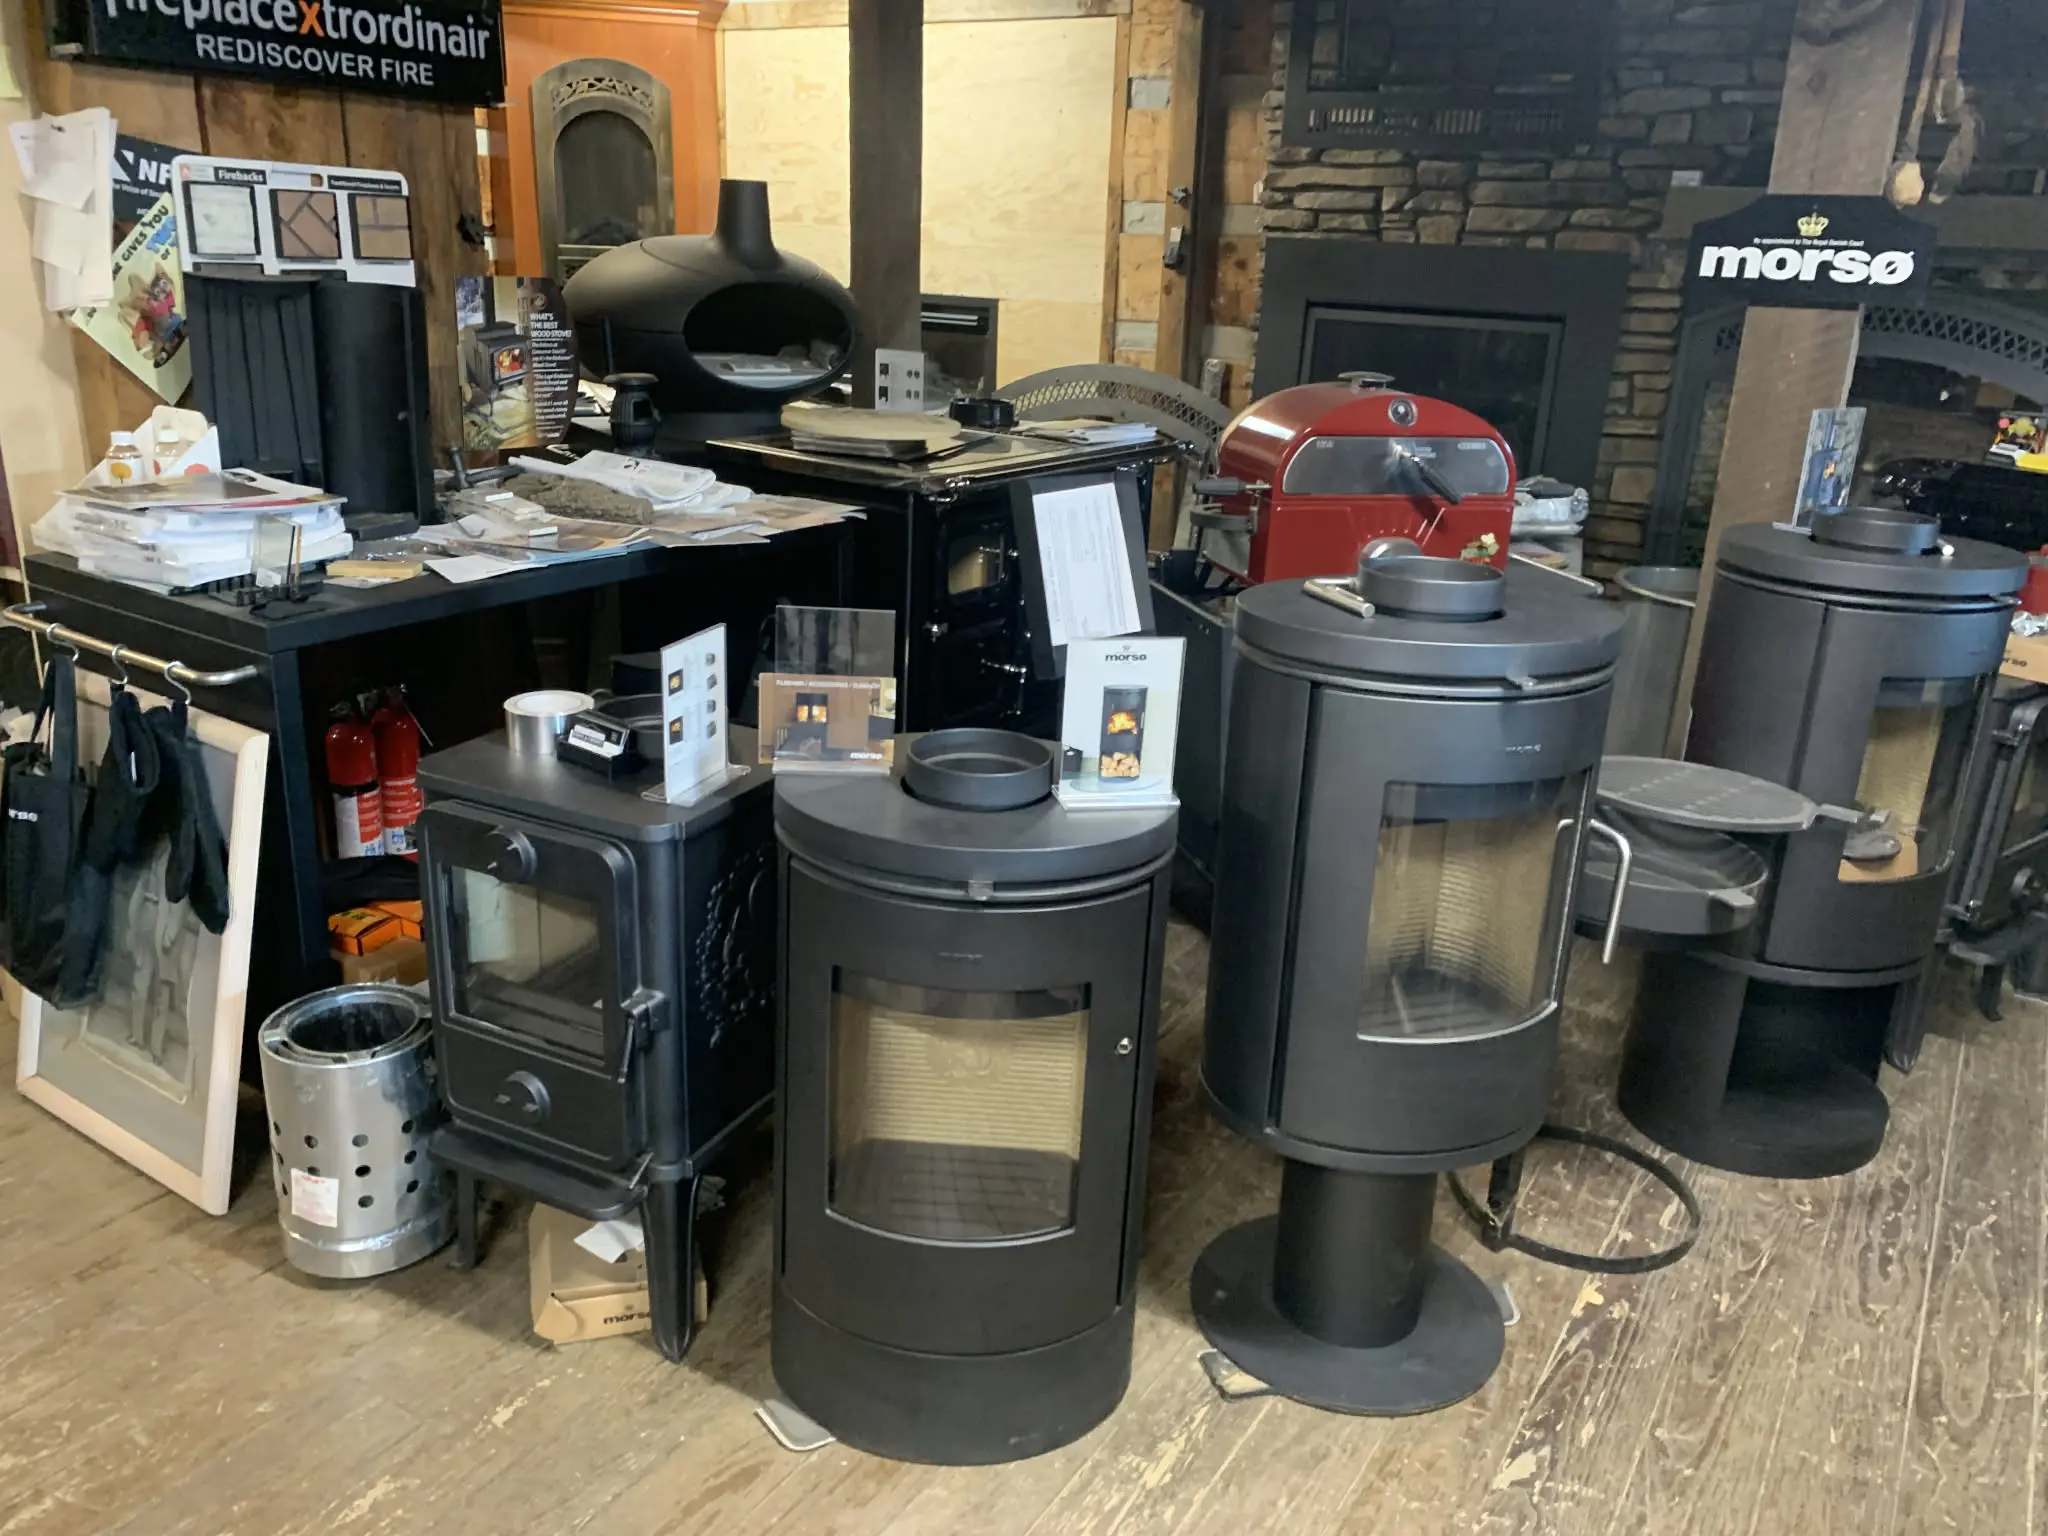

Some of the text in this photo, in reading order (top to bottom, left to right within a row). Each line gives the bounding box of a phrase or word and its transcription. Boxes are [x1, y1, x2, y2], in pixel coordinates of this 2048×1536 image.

[196, 33, 434, 86] REDISCOVER FIRE
[218, 170, 264, 182] Firebacks
[121, 231, 148, 262] GIVES
[144, 203, 170, 230] YOU
[1699, 246, 1915, 285] morsø
[530, 313, 554, 321] WHAT'S
[530, 321, 542, 329] THE
